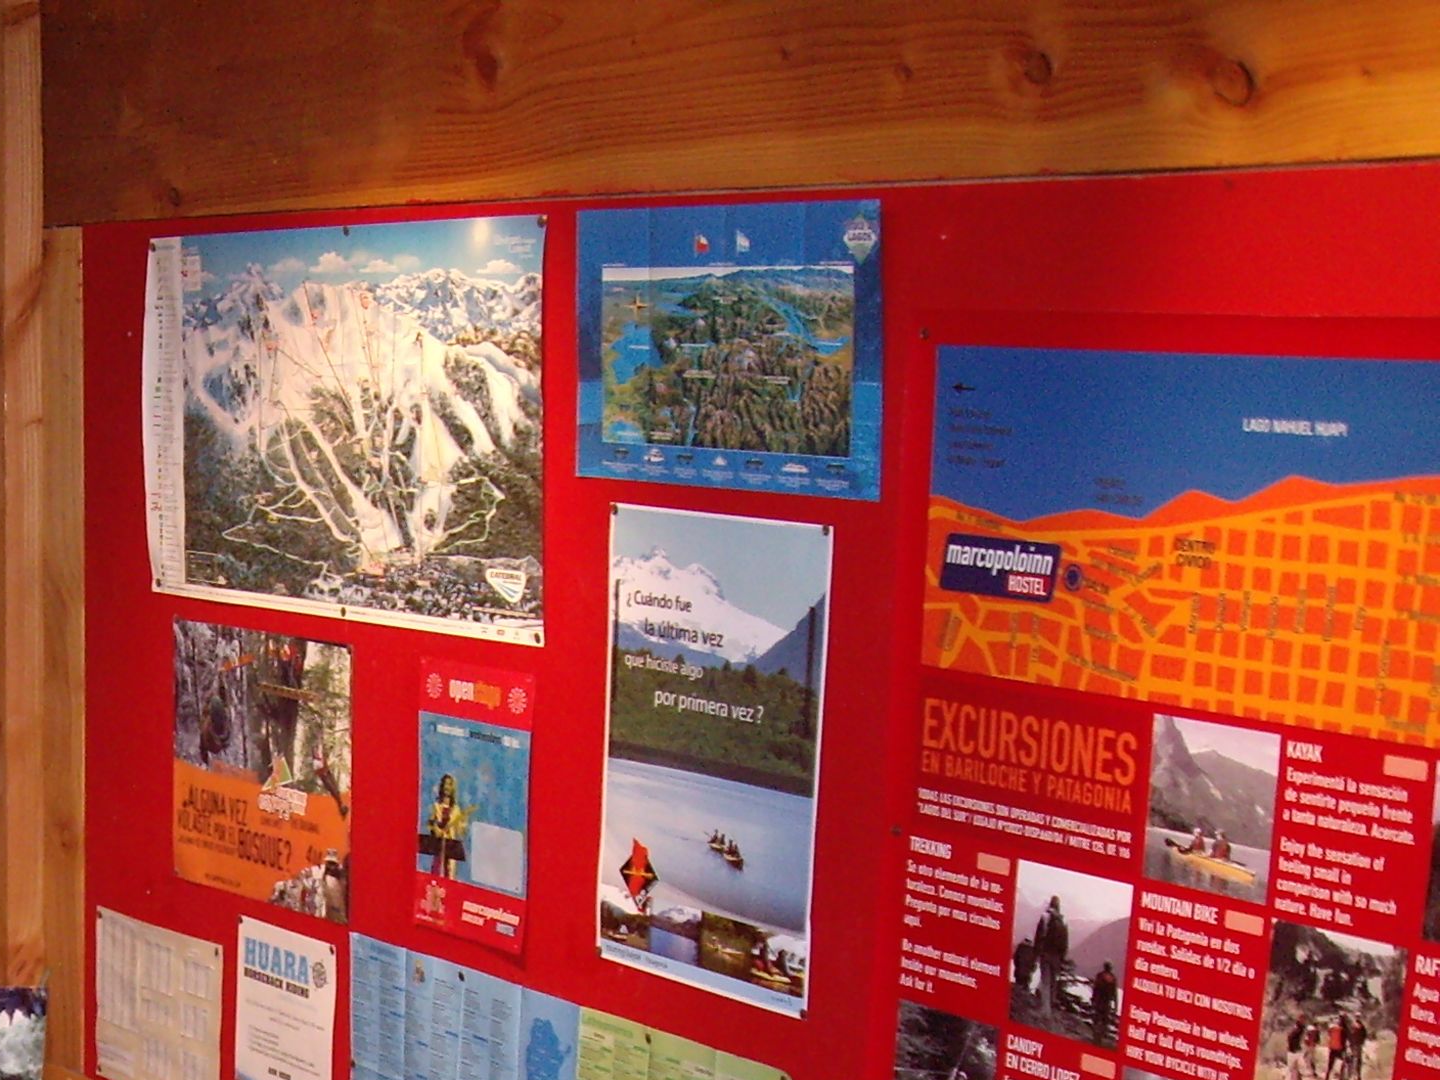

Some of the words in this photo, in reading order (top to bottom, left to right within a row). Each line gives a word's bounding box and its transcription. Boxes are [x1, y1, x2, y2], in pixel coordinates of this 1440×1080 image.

[1242, 417, 1271, 433] LAGO
[1272, 418, 1313, 436] NAHUEL
[946, 543, 1054, 576] marcopoloinn
[1007, 573, 1047, 596] HOSTEL
[633, 590, 673, 610] Cuándo
[675, 595, 692, 613] fue
[644, 617, 655, 637] la
[659, 618, 699, 644] última
[702, 632, 724, 648] vez
[624, 653, 645, 669] que
[646, 654, 679, 675] hiciste
[680, 664, 704, 681] algo
[654, 689, 676, 708] por
[678, 694, 729, 719] primera
[730, 704, 754, 723] vez
[921, 697, 1138, 786] EXCURSIONES
[1286, 740, 1323, 763] KAYAK
[921, 751, 940, 773] EN
[944, 754, 1028, 793] BARILOCHE
[1032, 771, 1043, 795] Y
[1046, 774, 1132, 814] PATAGONIA
[238, 828, 292, 872] BOSQUE?
[1141, 891, 1193, 918] MOUNTAIN
[1193, 903, 1220, 925] BIKE
[243, 936, 309, 985] HUARA
[1007, 1034, 1044, 1059] CANOPY
